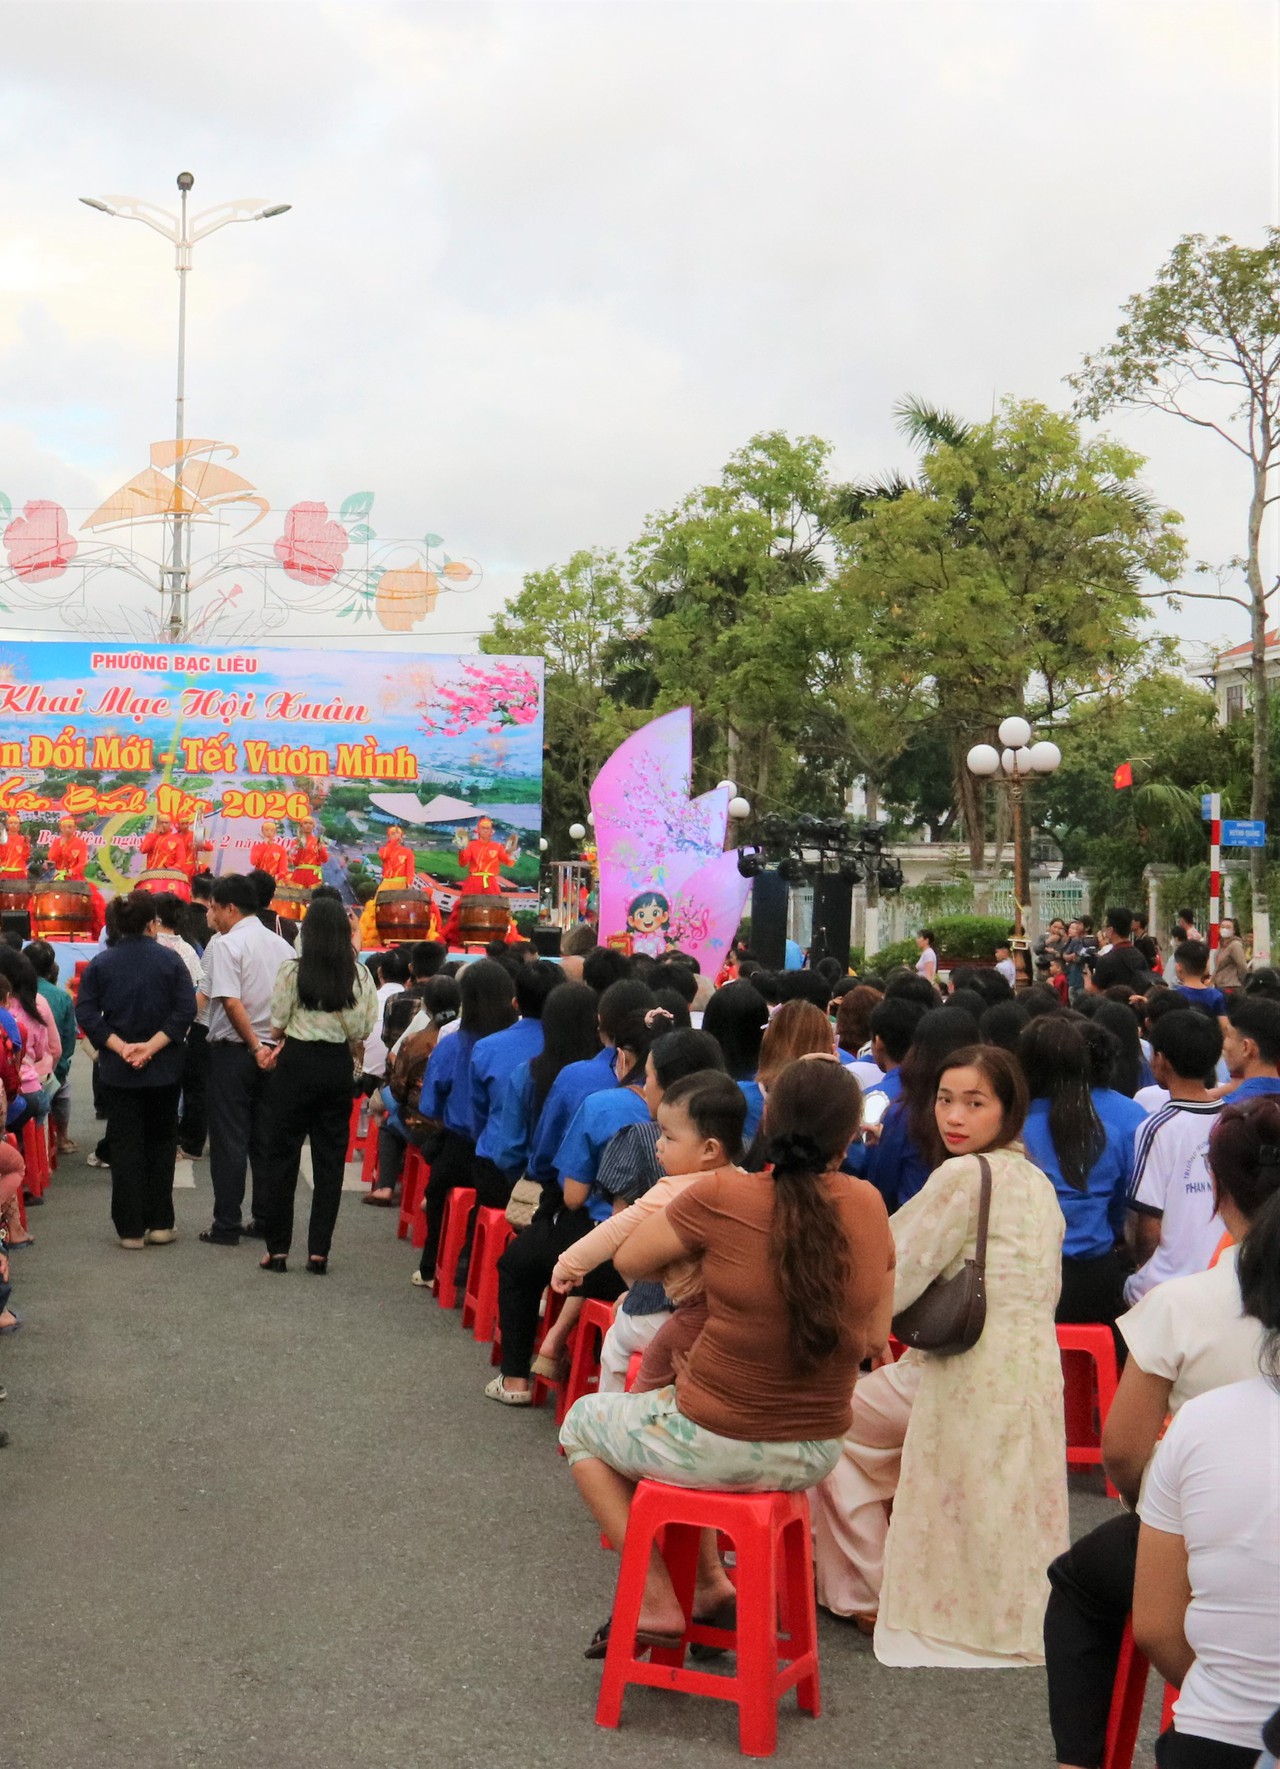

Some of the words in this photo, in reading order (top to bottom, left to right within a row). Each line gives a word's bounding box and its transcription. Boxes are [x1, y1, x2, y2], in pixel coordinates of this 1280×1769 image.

[93, 652, 168, 670] PHƯỜNG
[174, 656, 210, 674] BẠC
[217, 655, 257, 673] LIÊU
[89, 686, 169, 722] Mạc
[182, 688, 254, 724] Hội
[265, 691, 369, 722] Xuân
[29, 726, 86, 769] Đổi
[93, 735, 153, 770] Mới
[181, 732, 237, 773] Tết
[244, 739, 329, 776] Vươn
[335, 735, 418, 779] Mình
[222, 789, 311, 821] 2026
[220, 834, 232, 848] 2
